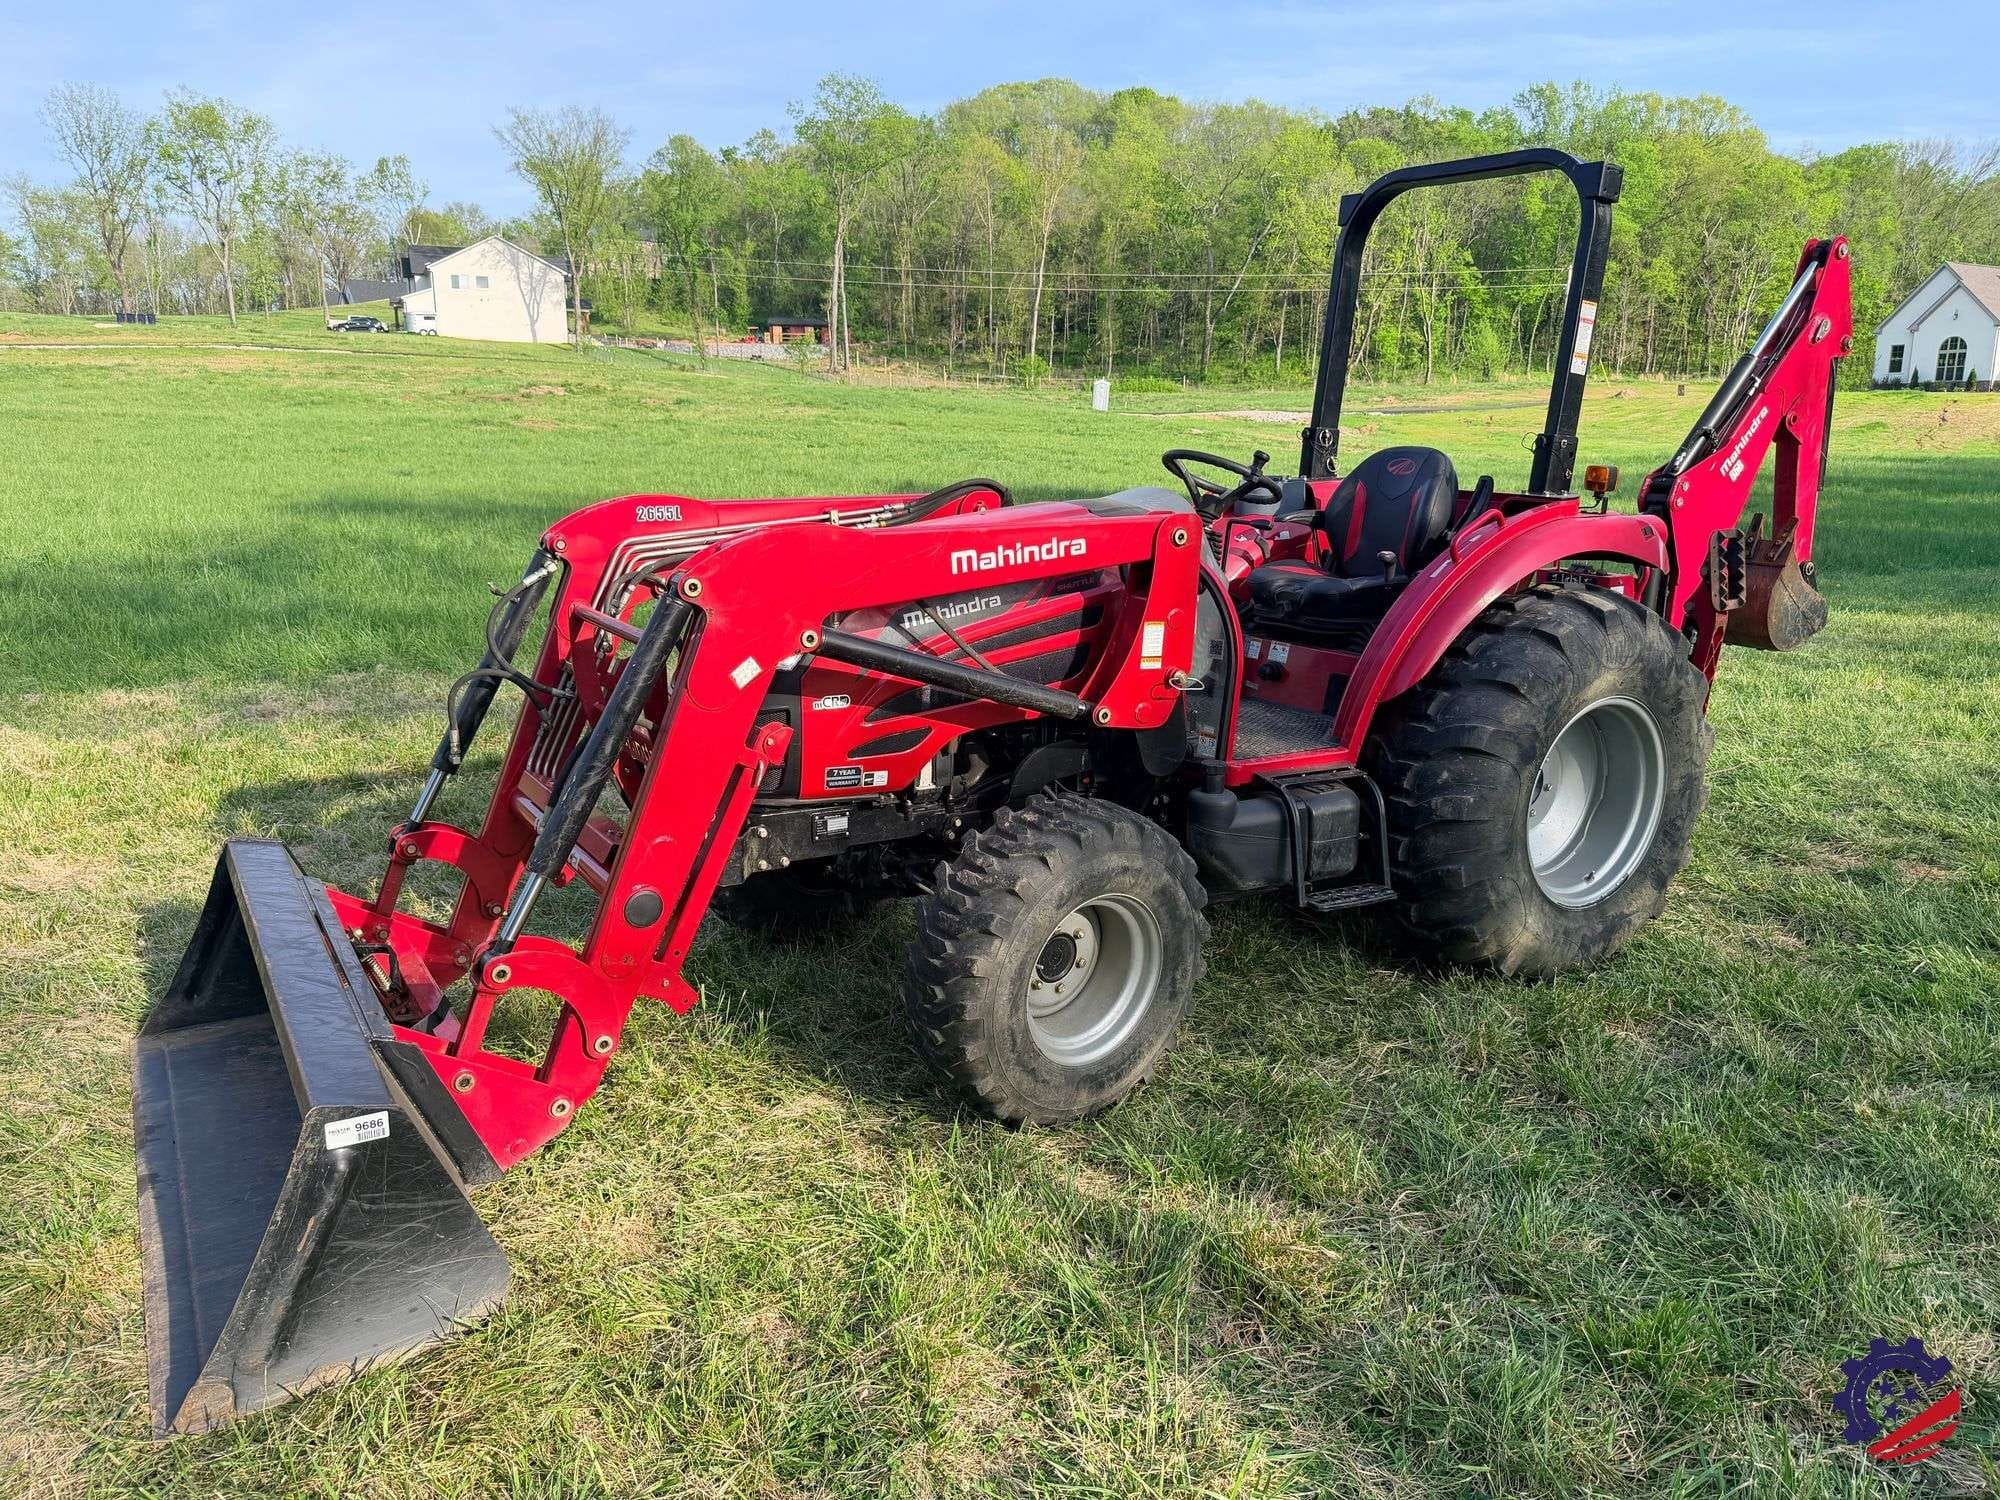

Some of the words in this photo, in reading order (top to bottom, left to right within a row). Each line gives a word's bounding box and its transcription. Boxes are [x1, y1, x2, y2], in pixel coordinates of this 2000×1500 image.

[1720, 406, 1768, 477] Mahindra
[636, 505, 682, 521] 2655L
[951, 536, 1087, 575] Mahindra
[833, 769, 839, 777] 7
[355, 1118, 384, 1131] 9686
